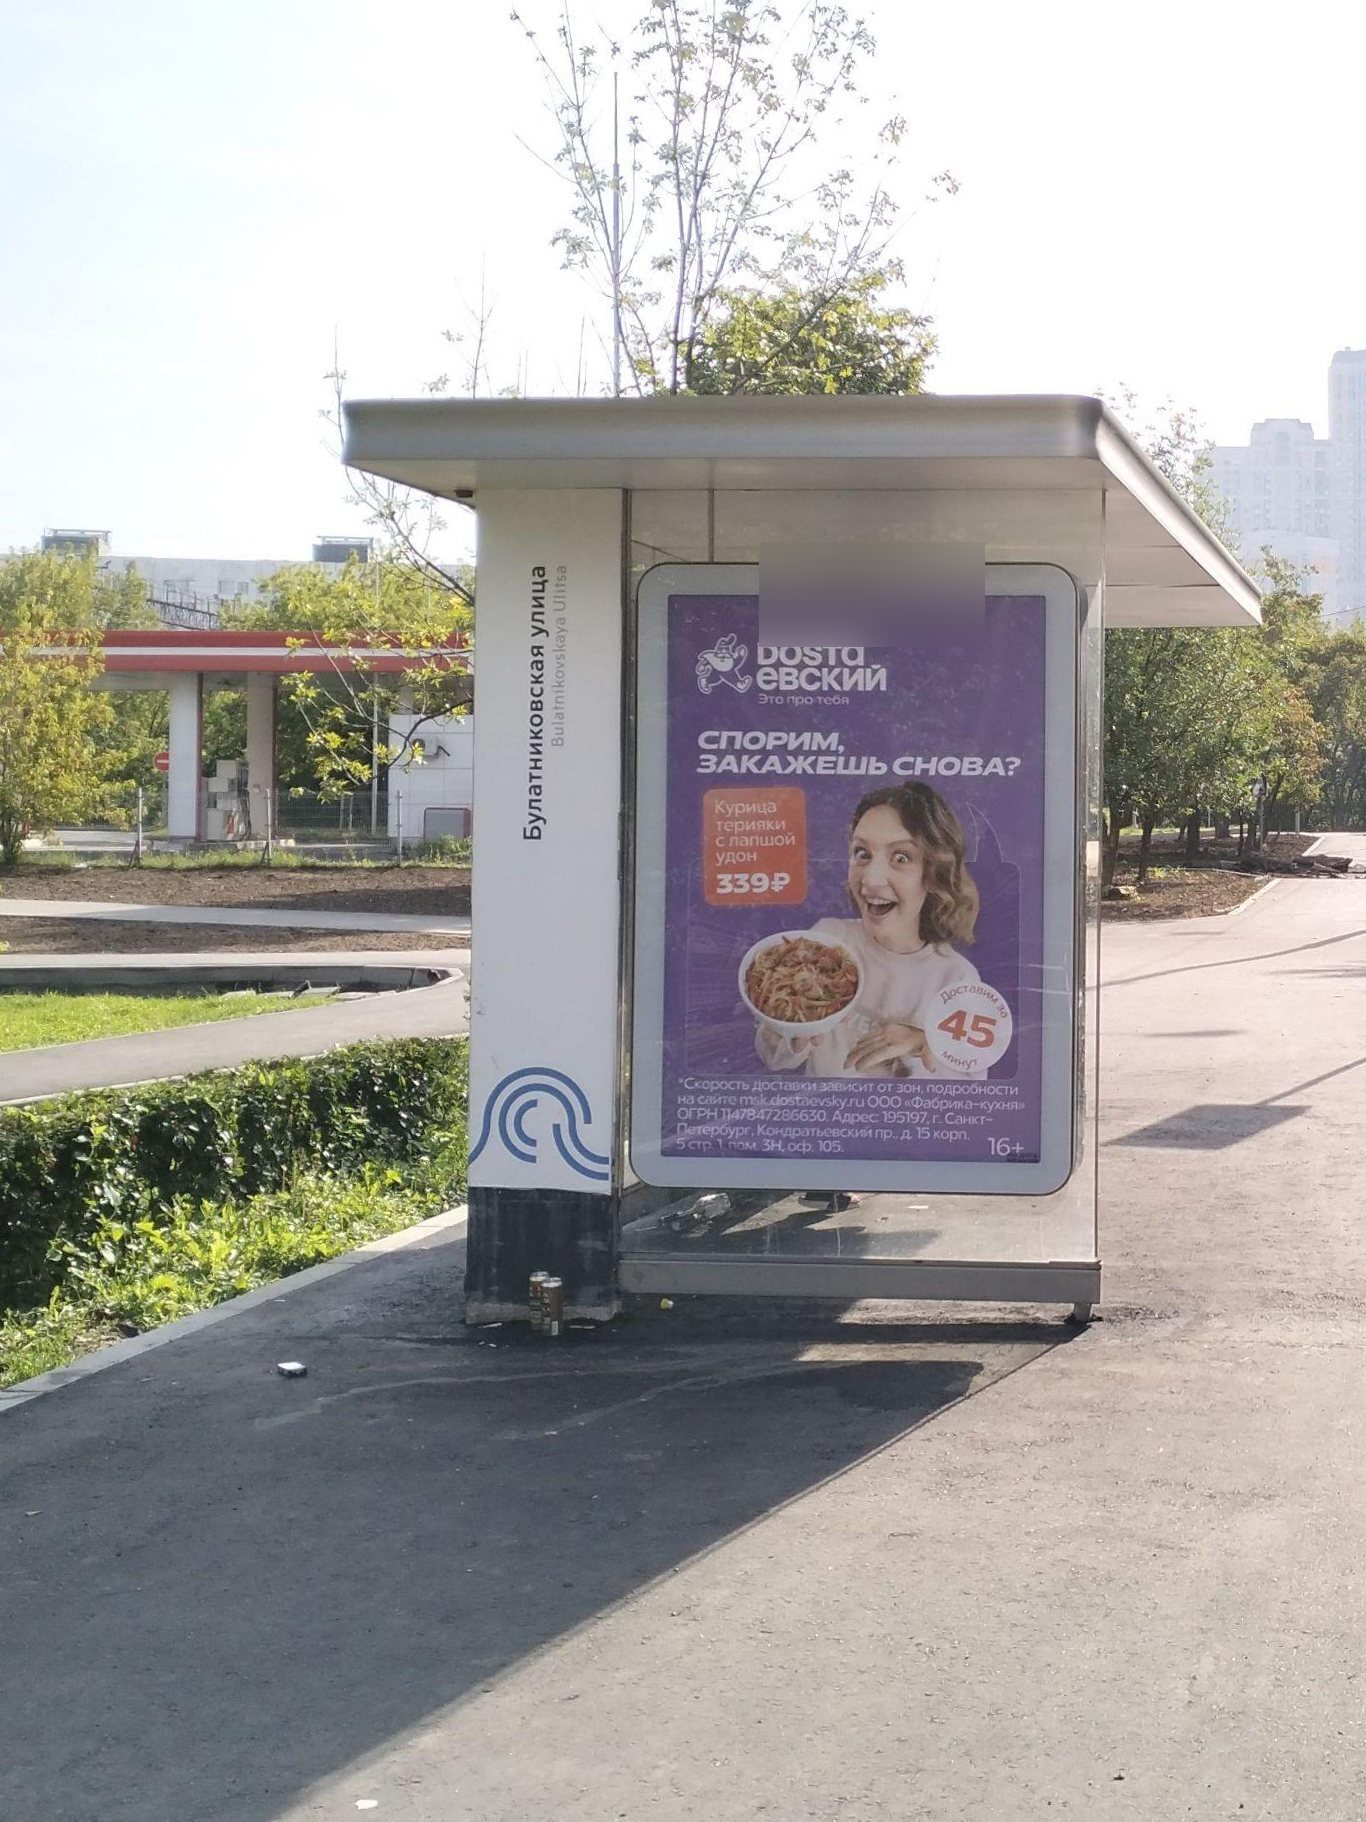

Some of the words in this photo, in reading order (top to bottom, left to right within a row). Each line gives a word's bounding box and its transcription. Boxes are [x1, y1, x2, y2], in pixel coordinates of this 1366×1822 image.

[554, 564, 567, 613] Ulitsa
[530, 565, 549, 637] улица
[551, 617, 568, 747] Bulatnikovskaya
[758, 694, 784, 706] Это
[786, 695, 813, 708] про
[816, 694, 850, 706] тебя
[523, 645, 547, 840] Булатниковская
[697, 730, 845, 754] СПОРИМ,
[696, 754, 887, 776] ЗАКАЖЕШЬ
[892, 756, 1022, 777] СНОВА?
[714, 799, 777, 819] Курица
[715, 818, 786, 835] терияки
[715, 835, 725, 847] с
[728, 830, 795, 848] лапшой
[715, 850, 757, 867] удон
[940, 985, 999, 1004] Доставим
[937, 1009, 997, 1048] 45
[941, 1050, 978, 1070] минут
[752, 1080, 817, 1092] доставки
[820, 1081, 874, 1093] зависит
[877, 1083, 893, 1093] от
[896, 1083, 924, 1095] зон,
[927, 1081, 1019, 1097] подробности
[677, 1095, 694, 1105] на
[698, 1094, 737, 1106] сайте
[740, 1094, 865, 1109] msk.dostaevsky.ru
[867, 1095, 902, 1108] ООО
[677, 1107, 717, 1120] ОГРН
[945, 1112, 993, 1125] Санкт-
[757, 1123, 873, 1140] Кондратьевский
[916, 1127, 931, 1139] 15
[933, 1129, 970, 1142] корп.
[788, 1140, 814, 1154] оф.
[818, 1140, 845, 1152] 105.
[988, 1137, 1024, 1156] 16+
